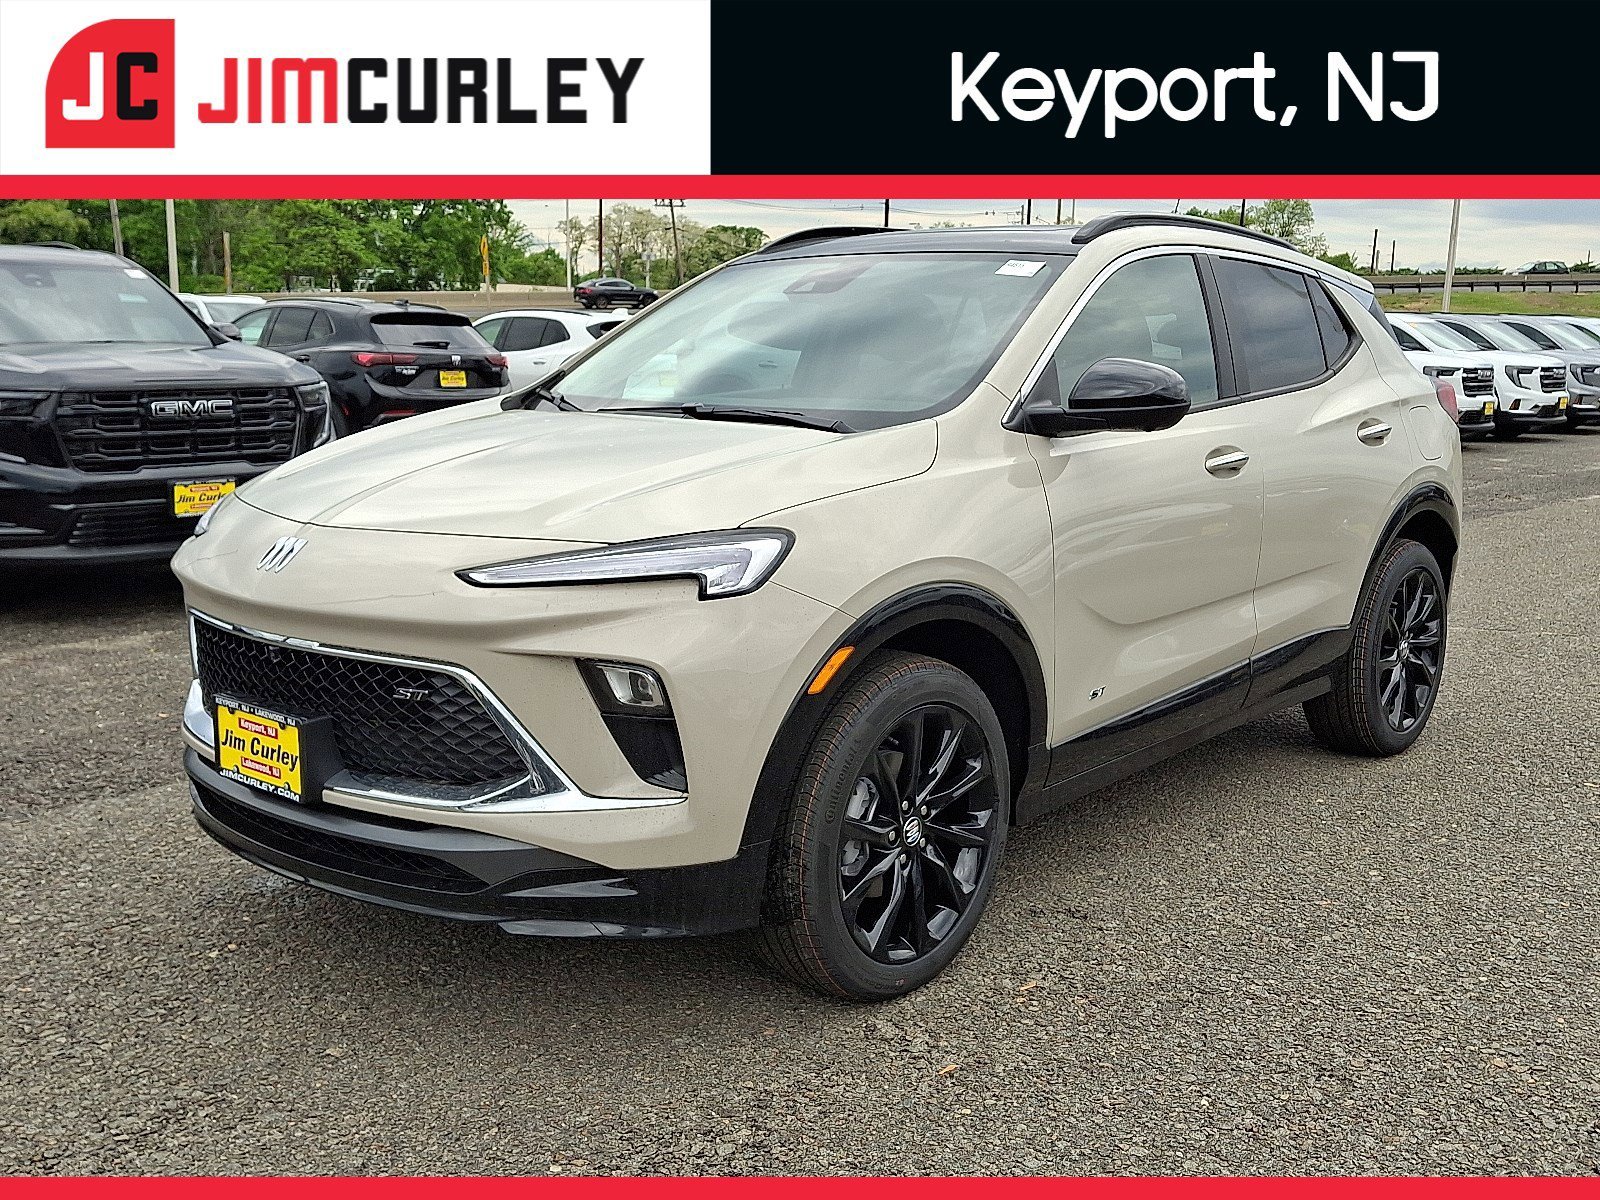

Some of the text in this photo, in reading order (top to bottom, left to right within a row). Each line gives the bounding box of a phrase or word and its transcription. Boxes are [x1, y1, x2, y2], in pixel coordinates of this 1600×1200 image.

[150, 399, 234, 417] GMC
[177, 492, 227, 504] Jim Curl
[392, 687, 429, 701] ST
[1089, 685, 1107, 701] ST
[240, 718, 276, 737] Keyport, NJ
[221, 728, 299, 772] Jim Curley
[272, 767, 280, 778] NJ
[219, 768, 300, 803] JIMCURLEY.COM
